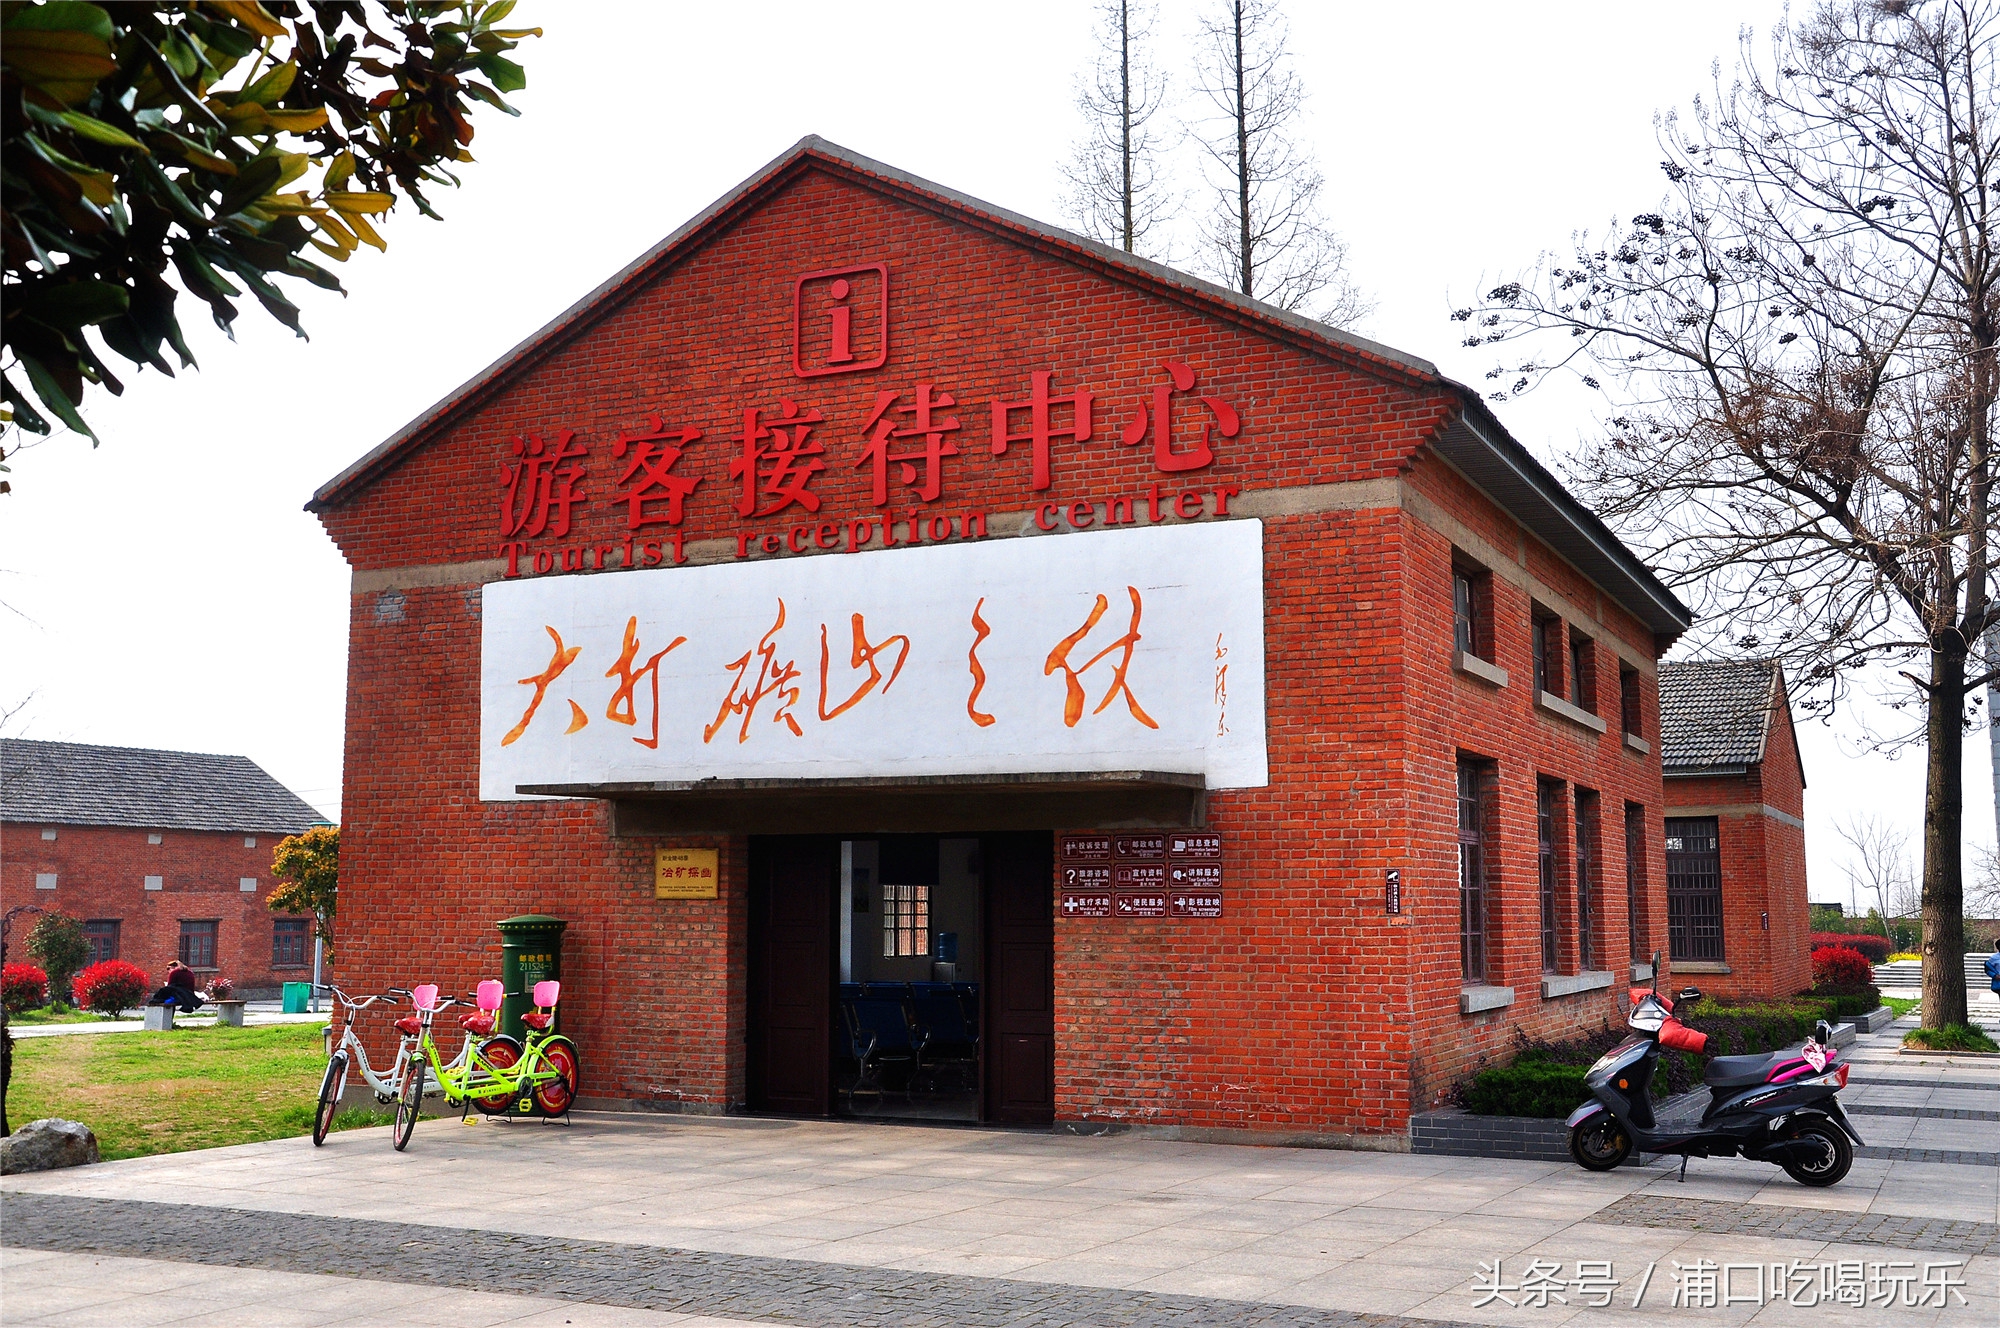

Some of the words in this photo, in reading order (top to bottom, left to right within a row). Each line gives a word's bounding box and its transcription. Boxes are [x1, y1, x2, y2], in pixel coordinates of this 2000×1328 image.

[500, 362, 1240, 538] 游客接待中心
[500, 529, 689, 578] Tourist
[735, 506, 988, 559] reception
[1035, 484, 1239, 532] center
[1132, 839, 1162, 848] 邮政电信
[1187, 838, 1219, 847] 信息查询
[1079, 869, 1109, 878] 旅游咨询
[1132, 868, 1163, 877] 宣传资料
[1188, 868, 1220, 877] 讲解服务
[1079, 898, 1109, 906] 医疗求助
[1133, 898, 1164, 907] 便民服务
[1188, 898, 1220, 906] 影视放映
